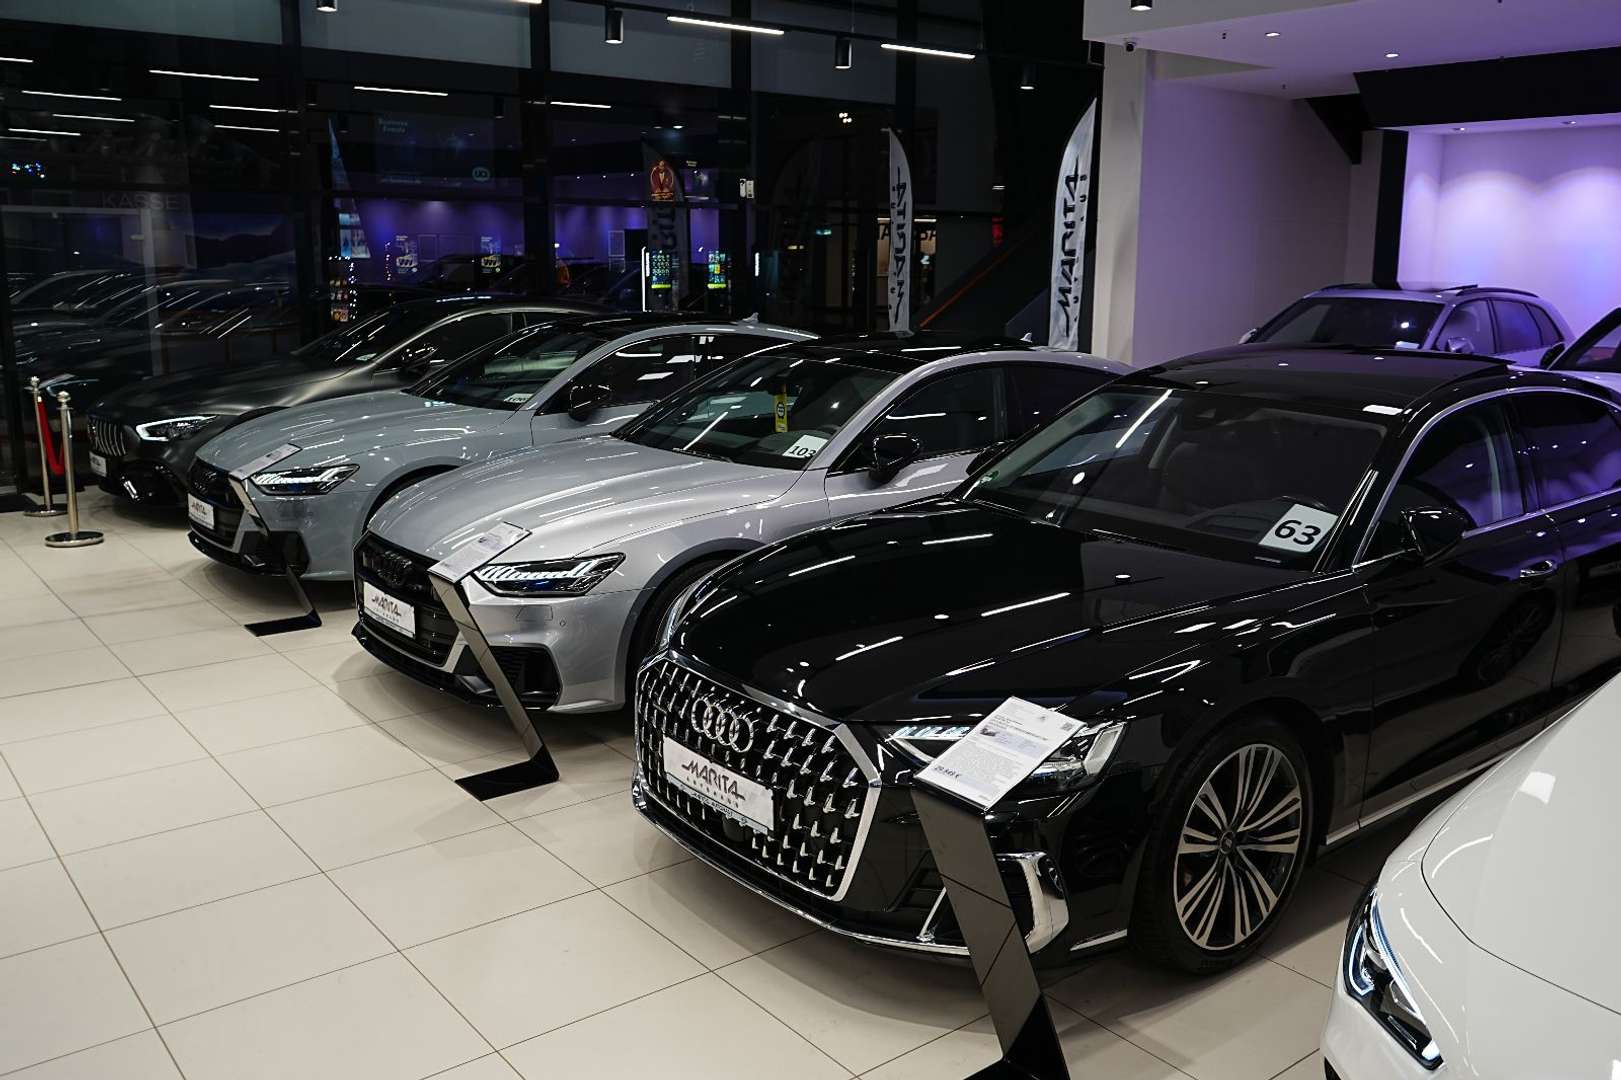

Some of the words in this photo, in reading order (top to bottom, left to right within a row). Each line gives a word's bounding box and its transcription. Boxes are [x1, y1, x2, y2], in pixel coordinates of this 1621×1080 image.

[1057, 155, 1078, 337] MARITA
[789, 445, 816, 459] 103
[1275, 519, 1321, 545] 63
[681, 760, 745, 801] MARITA
